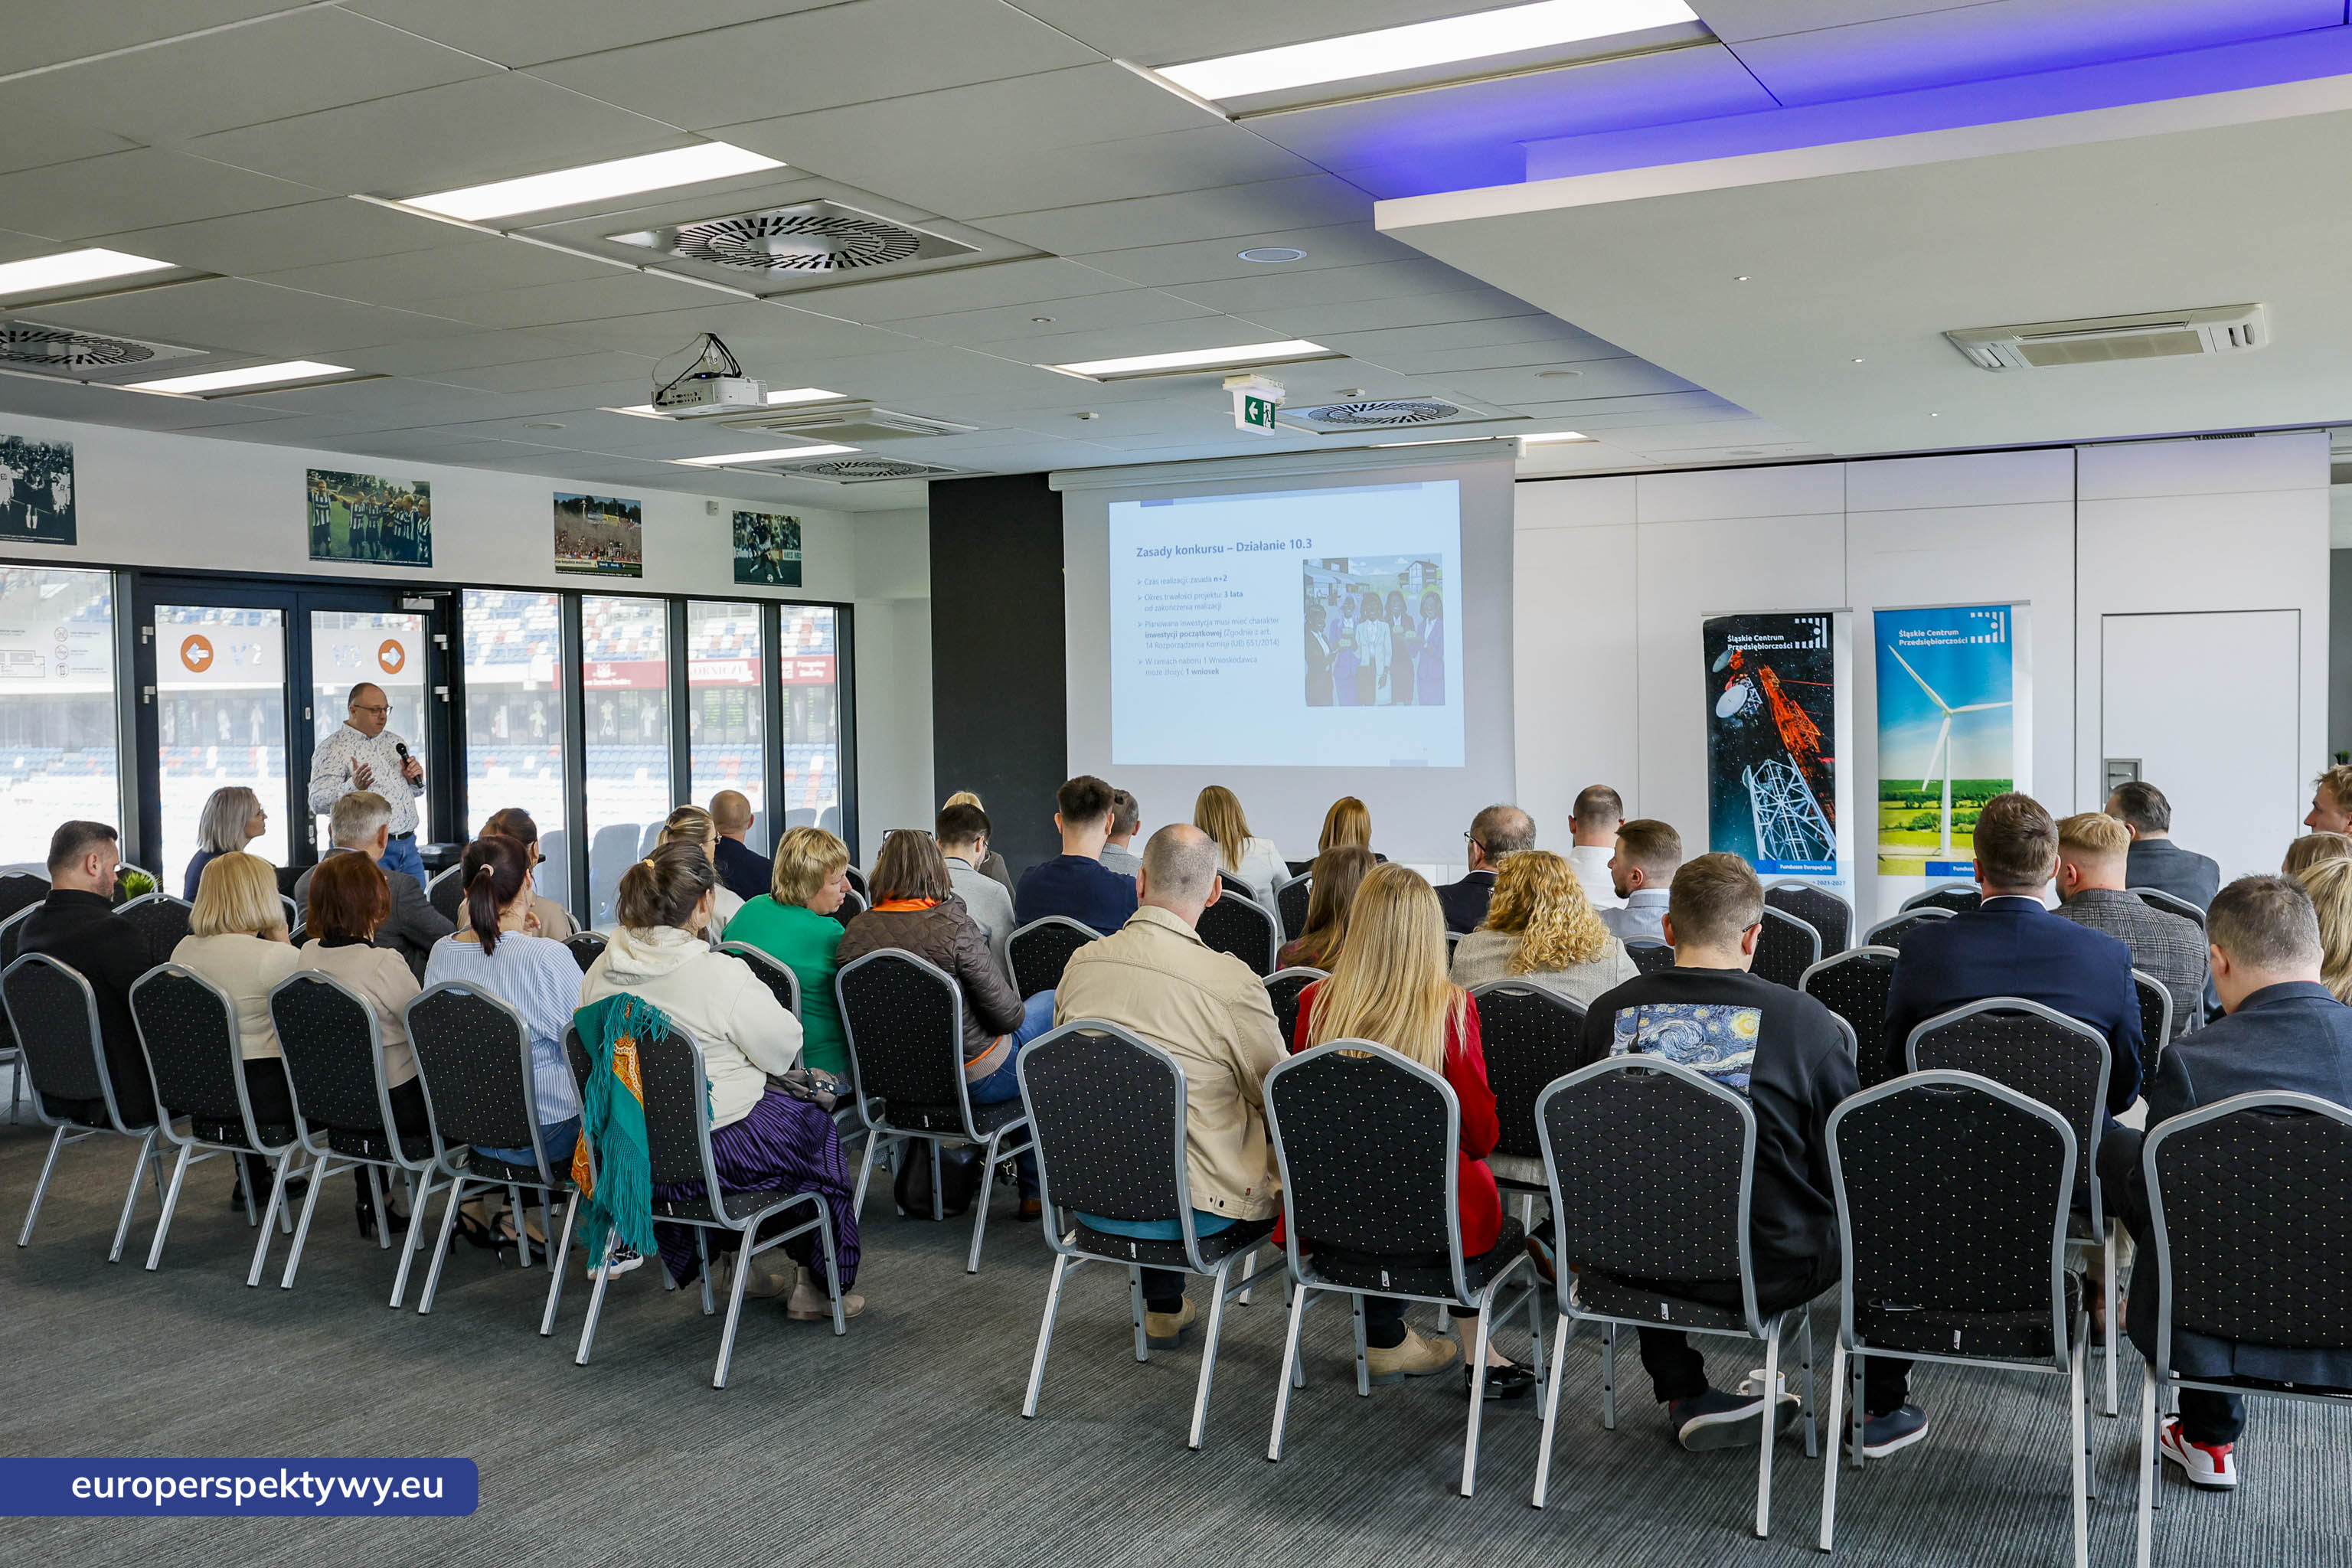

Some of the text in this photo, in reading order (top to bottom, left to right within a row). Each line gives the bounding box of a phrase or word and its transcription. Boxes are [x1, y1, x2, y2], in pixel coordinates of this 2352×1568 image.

[1136, 545, 1172, 559] Zasady
[1175, 544, 1223, 555] konkursu
[1236, 540, 1285, 552] Działanie
[1290, 538, 1312, 549] 10.3
[1180, 619, 1213, 628] inwestycja
[1249, 616, 1279, 625] charakter
[1145, 631, 1178, 639] inwestycji
[1179, 629, 1223, 639] początkowej
[1899, 629, 1926, 638] Śląskie
[1727, 634, 1753, 643] Śląskie
[1899, 637, 1968, 646] Przedsiębiorczości
[1155, 642, 1204, 650] Rozporządzenia
[1727, 642, 1793, 651] Przedsiębiorczości
